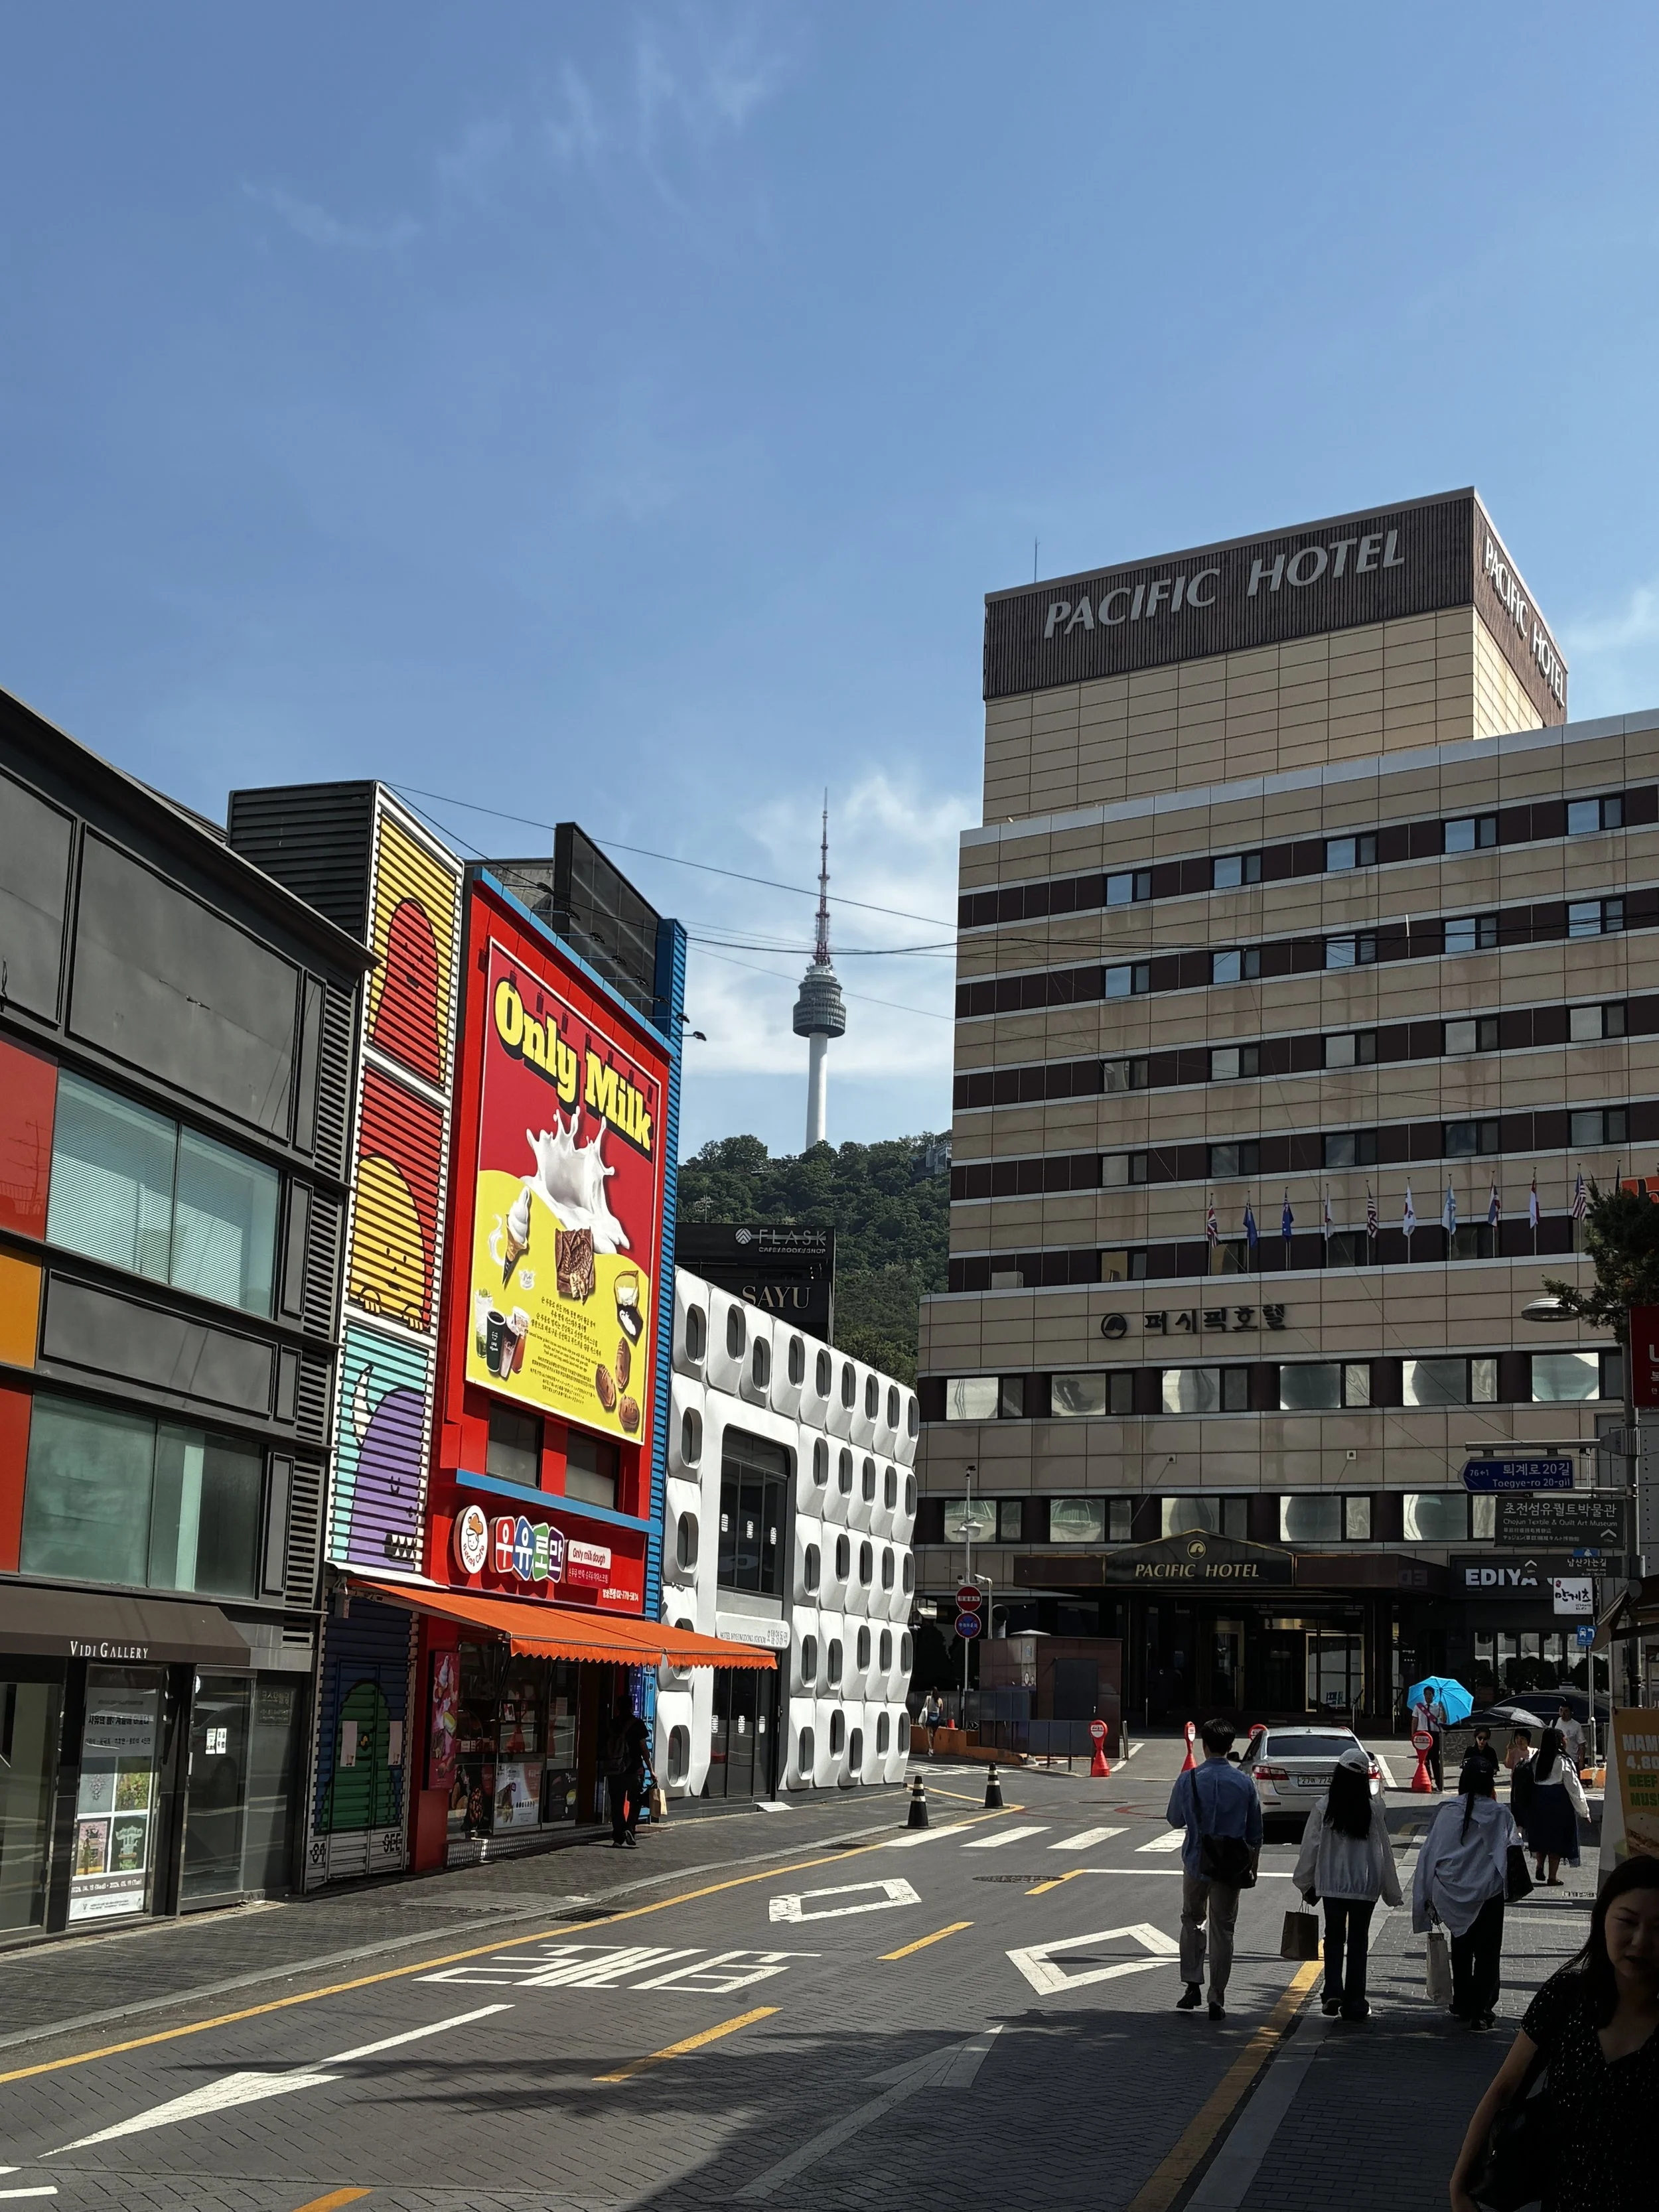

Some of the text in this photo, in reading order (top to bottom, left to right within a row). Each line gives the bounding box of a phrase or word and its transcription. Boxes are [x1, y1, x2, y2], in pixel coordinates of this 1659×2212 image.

[1044, 529, 1405, 639] PACIFIC HOTEL
[1484, 533, 1565, 708] PACIFIC HOTEL
[494, 979, 652, 1153] Only Milk
[758, 1229, 827, 1246] FLASK
[742, 1285, 812, 1309] SAYU
[1492, 1478, 1571, 1489] Toegye-ro 20-gil
[1135, 1563, 1260, 1578] PACIFIC HOTEL
[70, 1640, 149, 1659] VIDI GALLERY
[1623, 1734, 1659, 1752] MAM
[1629, 1774, 1657, 1788] BEEF
[1630, 1793, 1659, 1806] MUS
